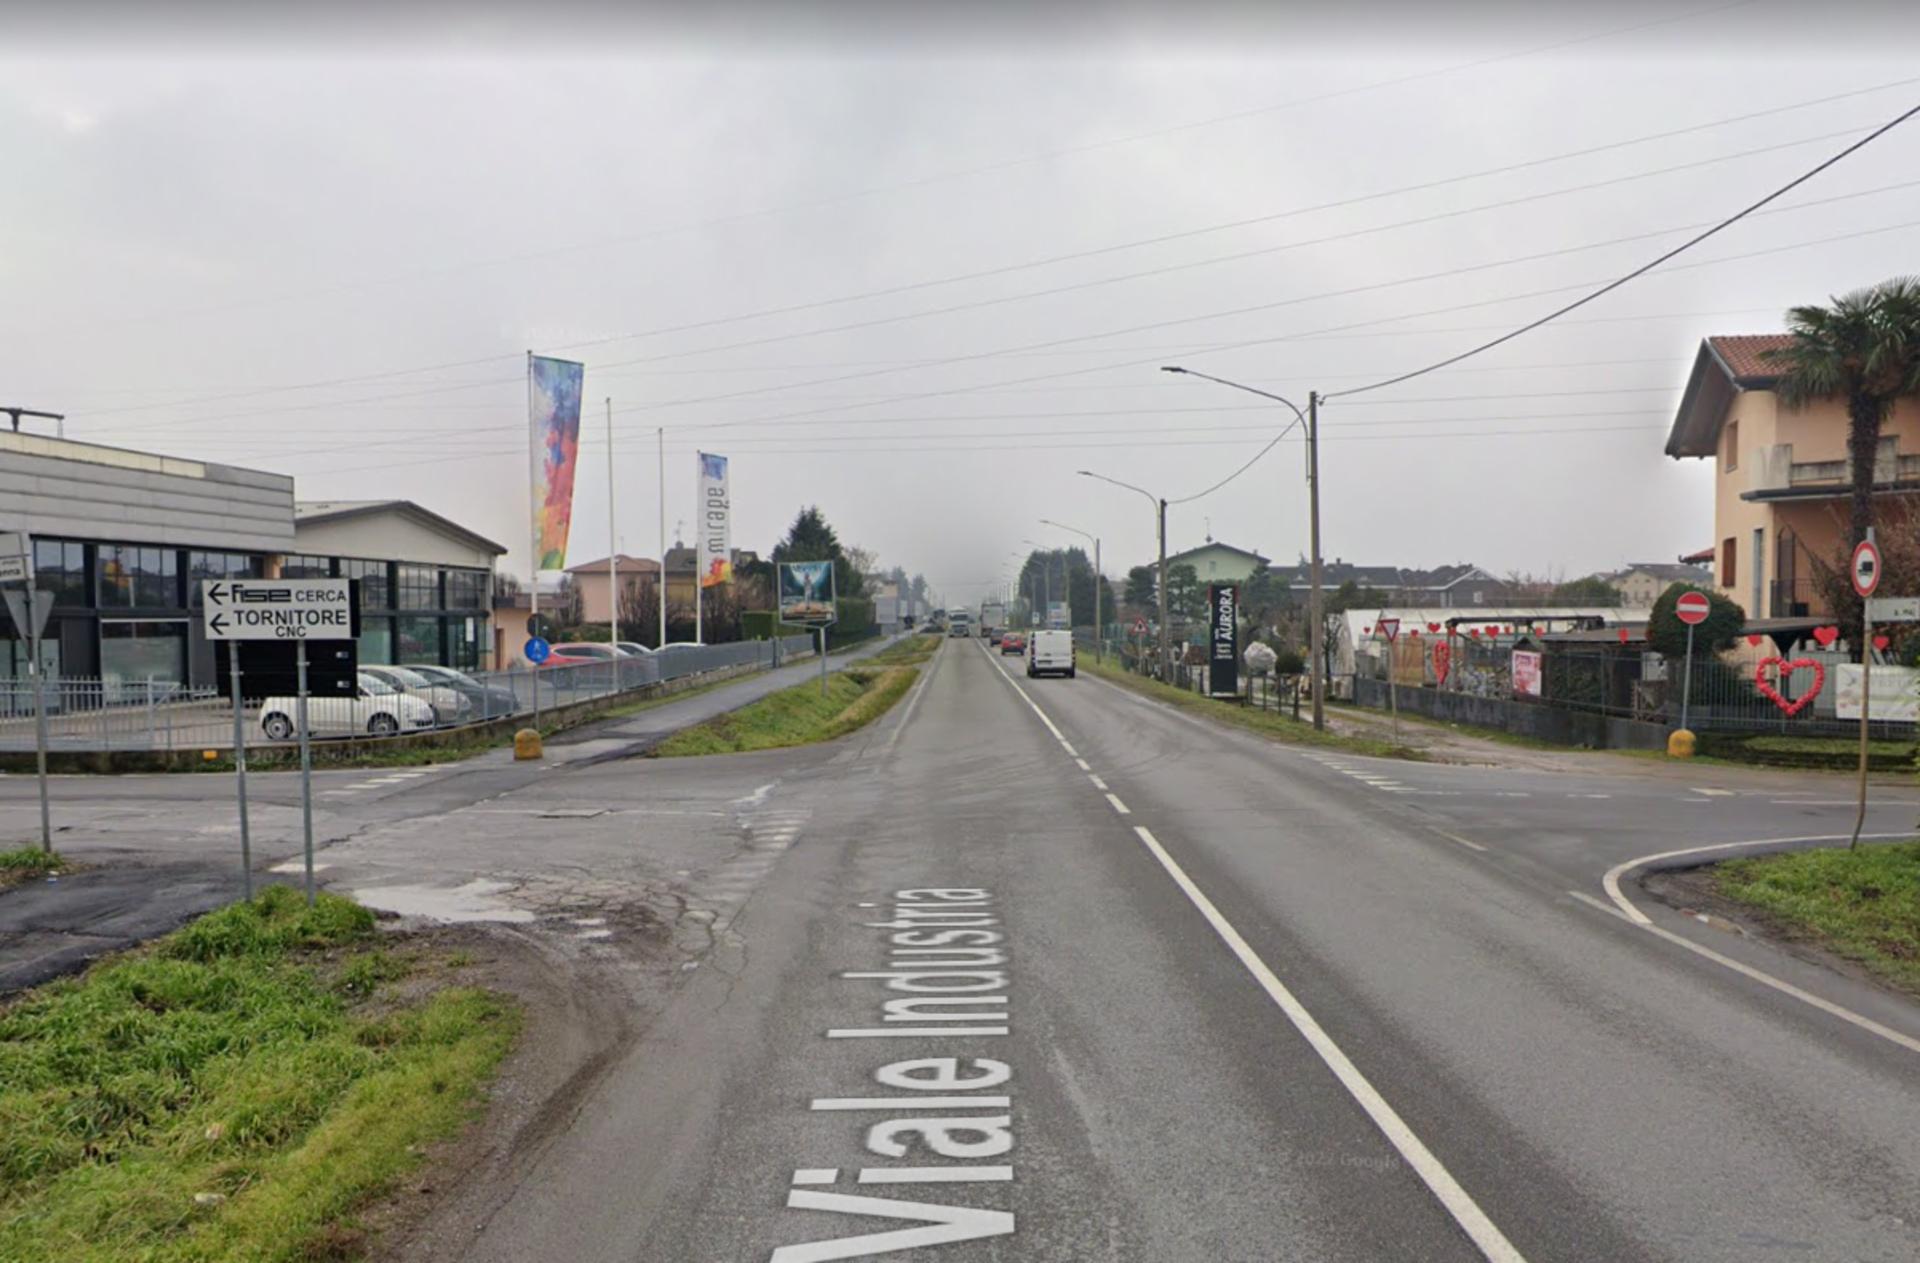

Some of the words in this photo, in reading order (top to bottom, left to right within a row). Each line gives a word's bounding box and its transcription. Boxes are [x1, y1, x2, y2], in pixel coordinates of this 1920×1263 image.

[707, 487, 729, 554] mirage
[295, 590, 347, 602] CERCA
[234, 610, 347, 625] TORNITORE
[1219, 588, 1233, 640] AURORA
[275, 626, 306, 637] CNC
